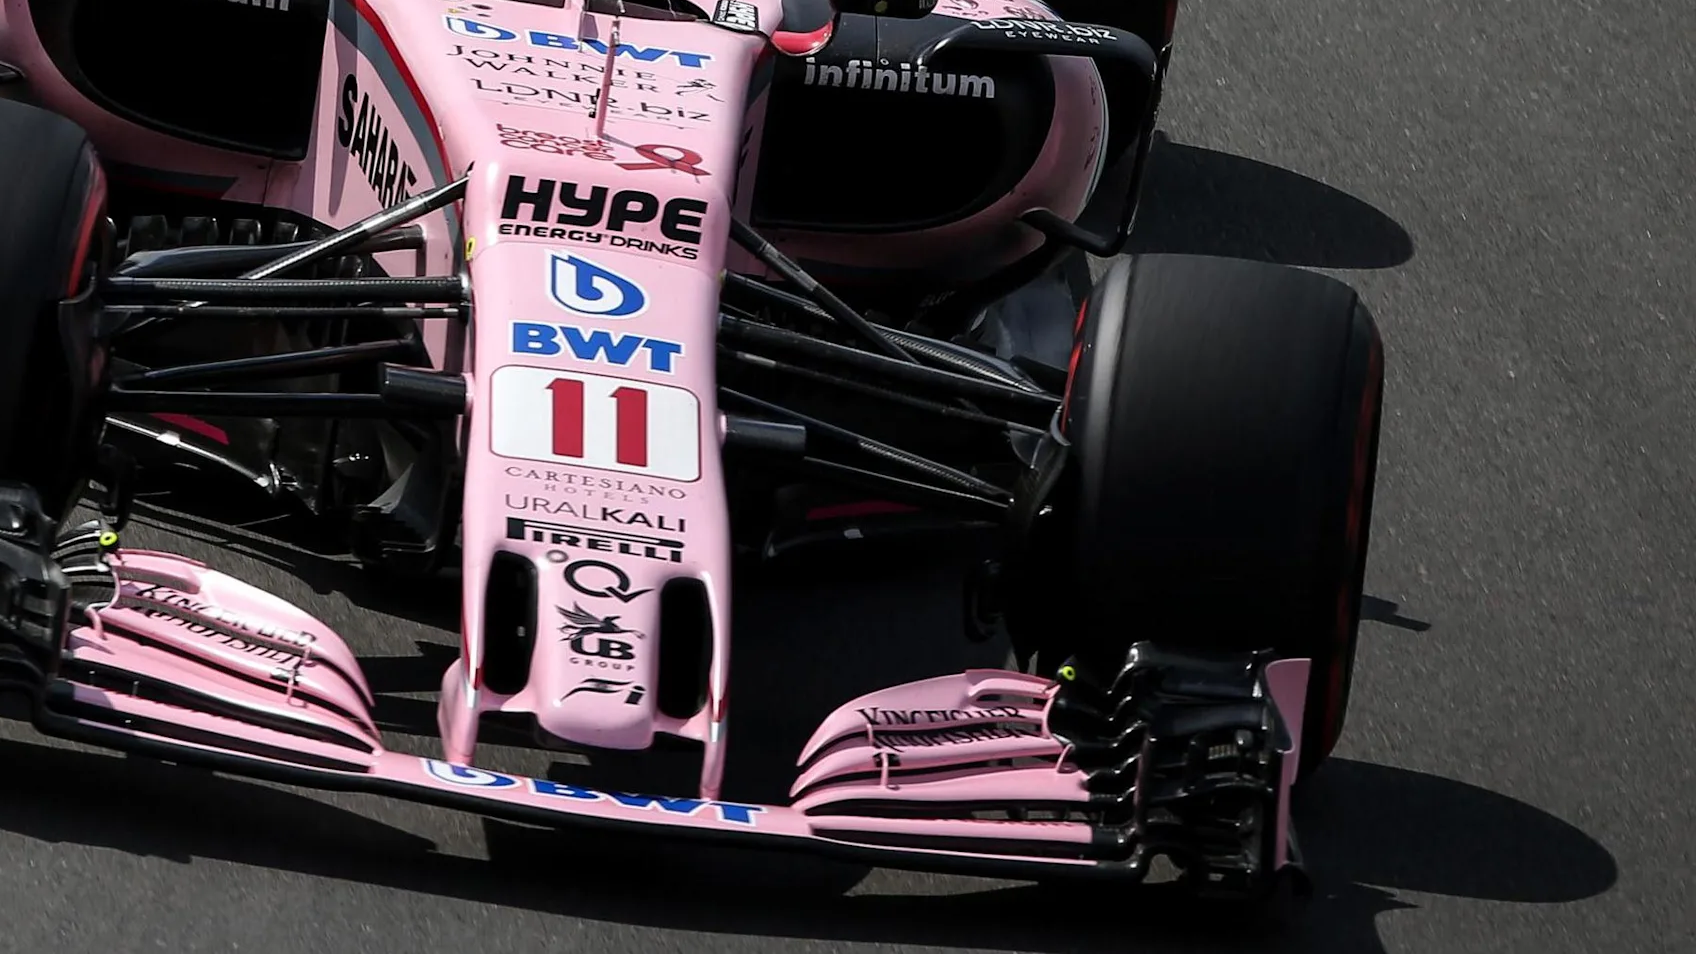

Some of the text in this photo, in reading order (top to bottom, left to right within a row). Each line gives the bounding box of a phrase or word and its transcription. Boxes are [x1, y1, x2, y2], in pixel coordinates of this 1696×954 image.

[971, 19, 1118, 41] LDNR.biz
[1005, 30, 1100, 45] EYEWEAR
[447, 44, 656, 81] JOHNNIE
[529, 30, 712, 68] BWT
[464, 58, 659, 93] WALKER
[804, 58, 996, 99] infinitum
[500, 140, 617, 161] care
[500, 175, 708, 245] HYPE
[498, 224, 699, 261] ENERGY DRINKS
[512, 322, 682, 374] BWT
[545, 378, 648, 468] 11
[504, 466, 686, 499] CARTESIANO
[544, 484, 650, 505] HOTELS
[505, 494, 686, 533] URALKALI
[506, 516, 686, 563] PIRELLI
[569, 657, 636, 672] GROUP
[570, 637, 636, 661] UB
[531, 779, 764, 824] BWT
